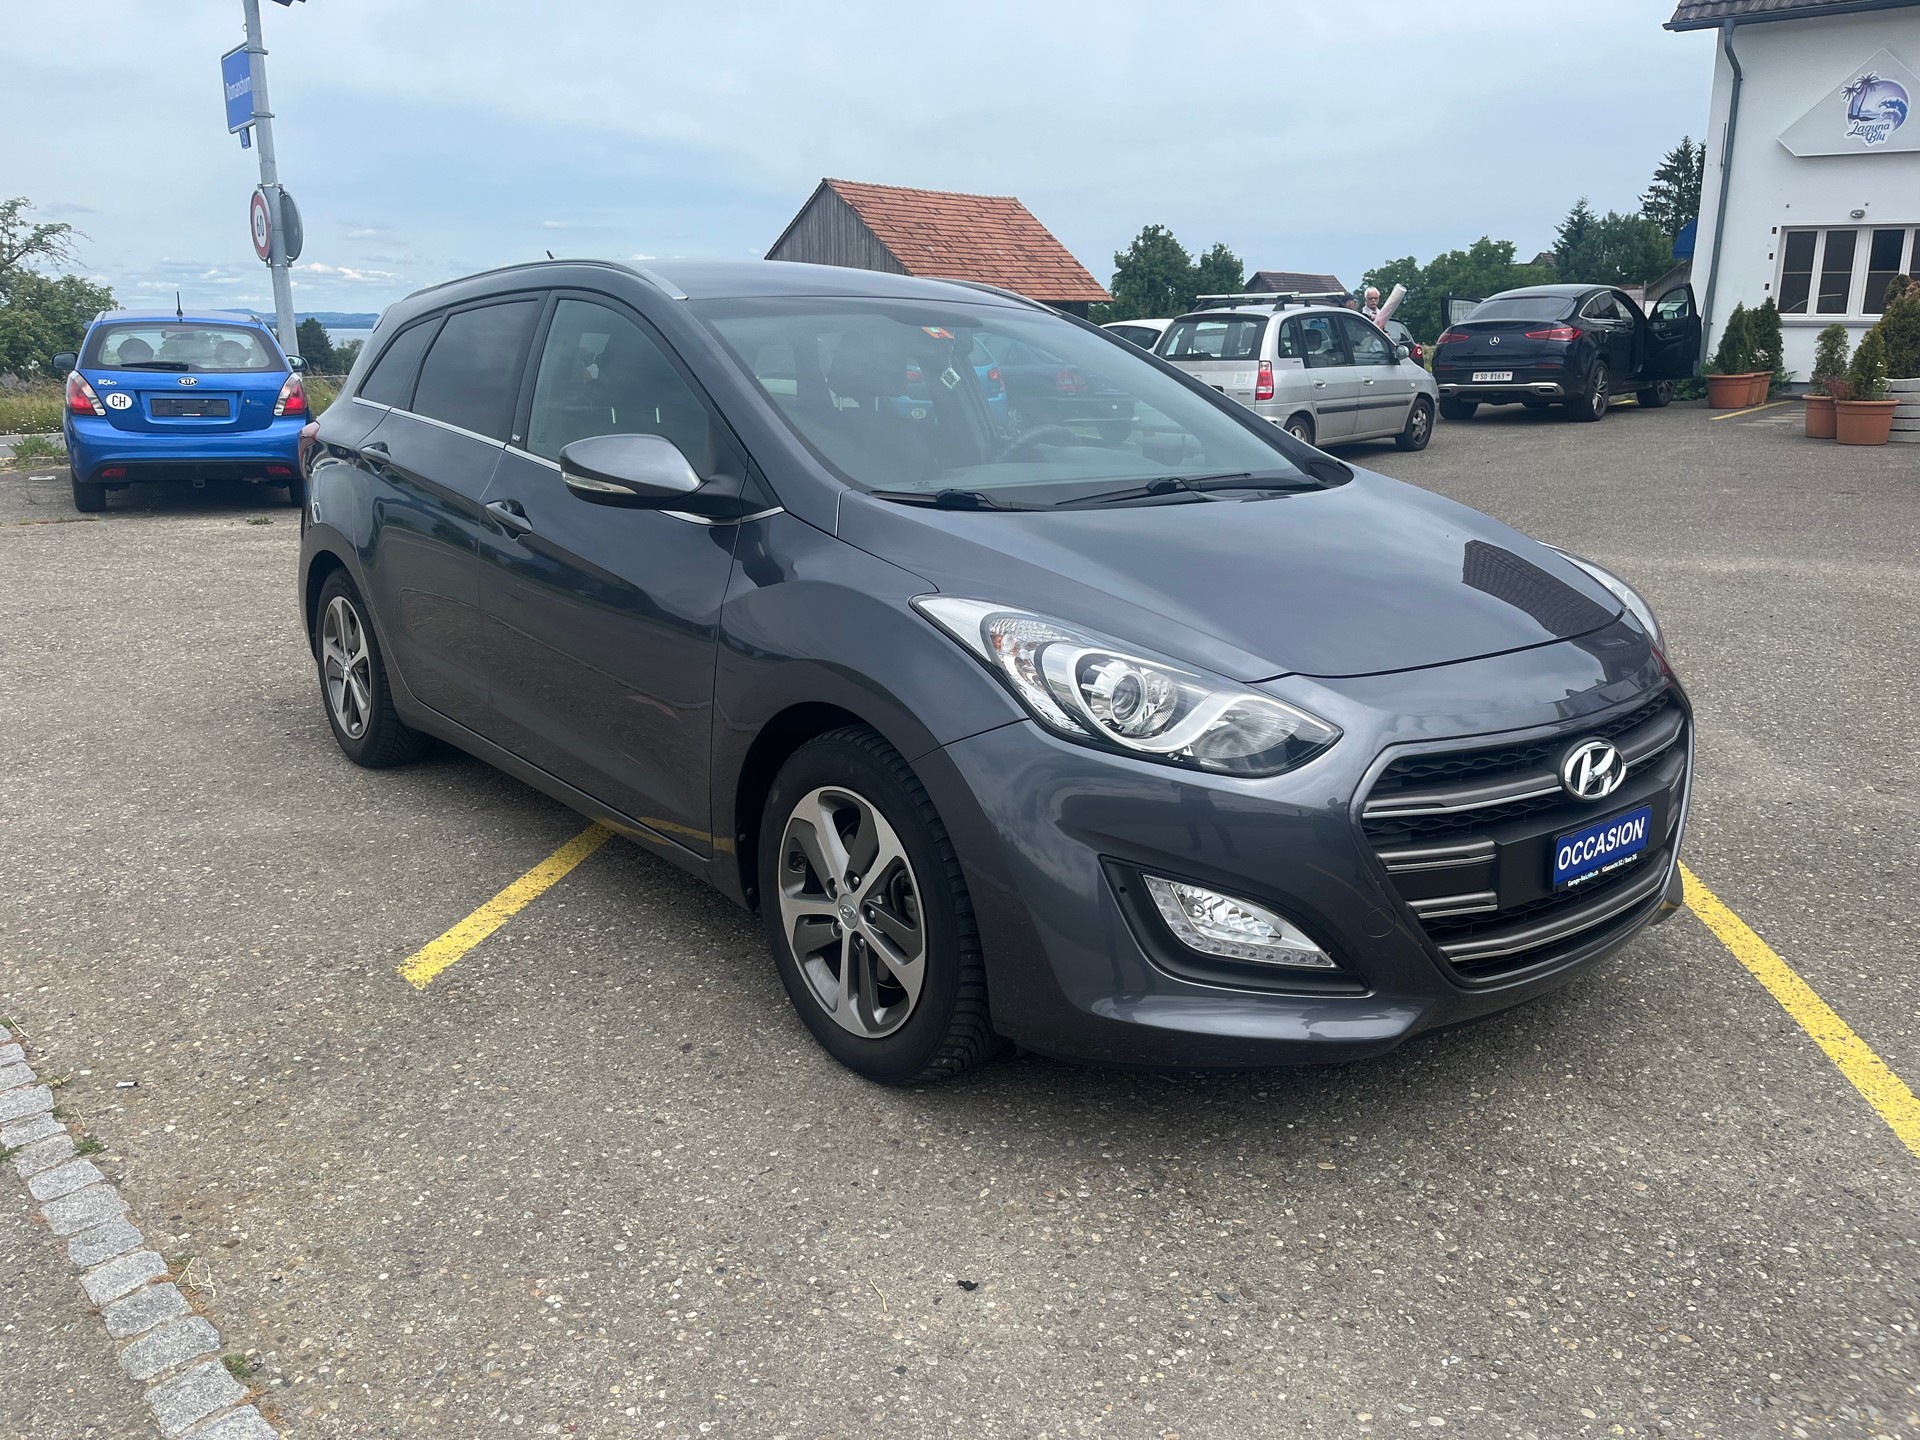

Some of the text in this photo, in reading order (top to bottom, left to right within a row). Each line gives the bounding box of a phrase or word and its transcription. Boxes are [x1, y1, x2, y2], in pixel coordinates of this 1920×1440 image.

[1847, 121, 1890, 136] Laguna
[1865, 130, 1886, 144] Blu
[180, 377, 196, 385] KIA
[112, 395, 126, 408] CH
[1557, 816, 1646, 871] OCCASION
